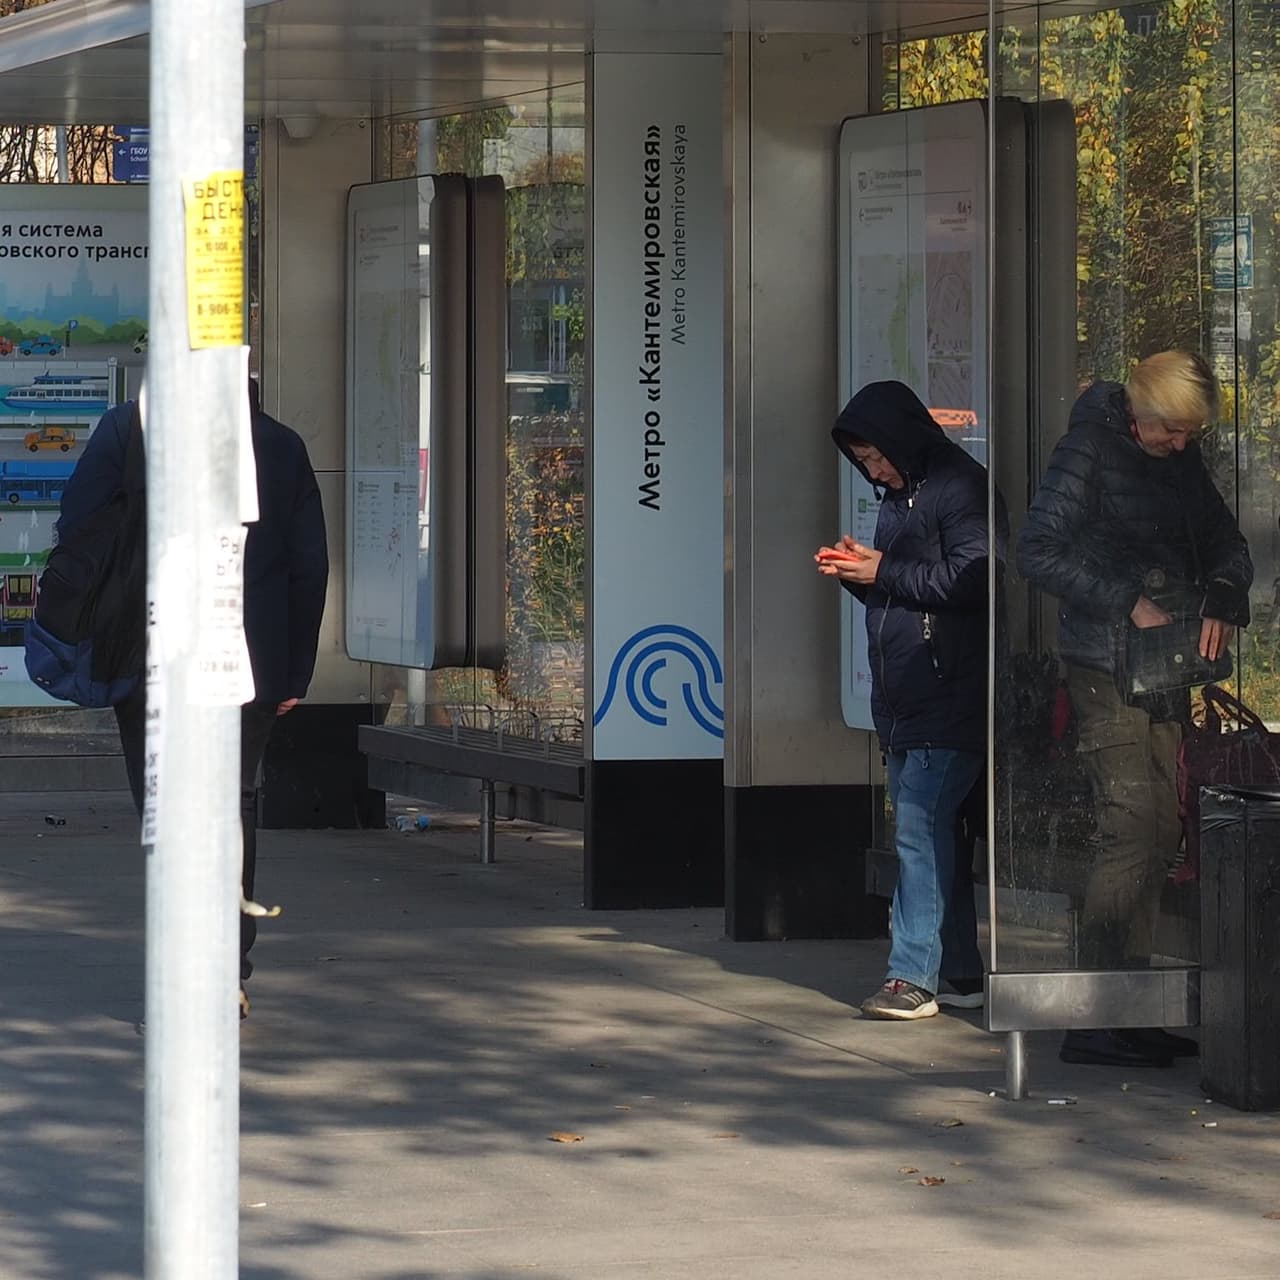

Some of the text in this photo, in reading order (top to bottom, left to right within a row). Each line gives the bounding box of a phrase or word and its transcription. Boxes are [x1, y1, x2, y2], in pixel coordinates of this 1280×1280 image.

[18, 223, 104, 238] система
[194, 180, 243, 198] БЫСТ
[670, 124, 687, 345] Metro Kantemirovskaya
[638, 124, 667, 511] Метро «Кантемировская»
